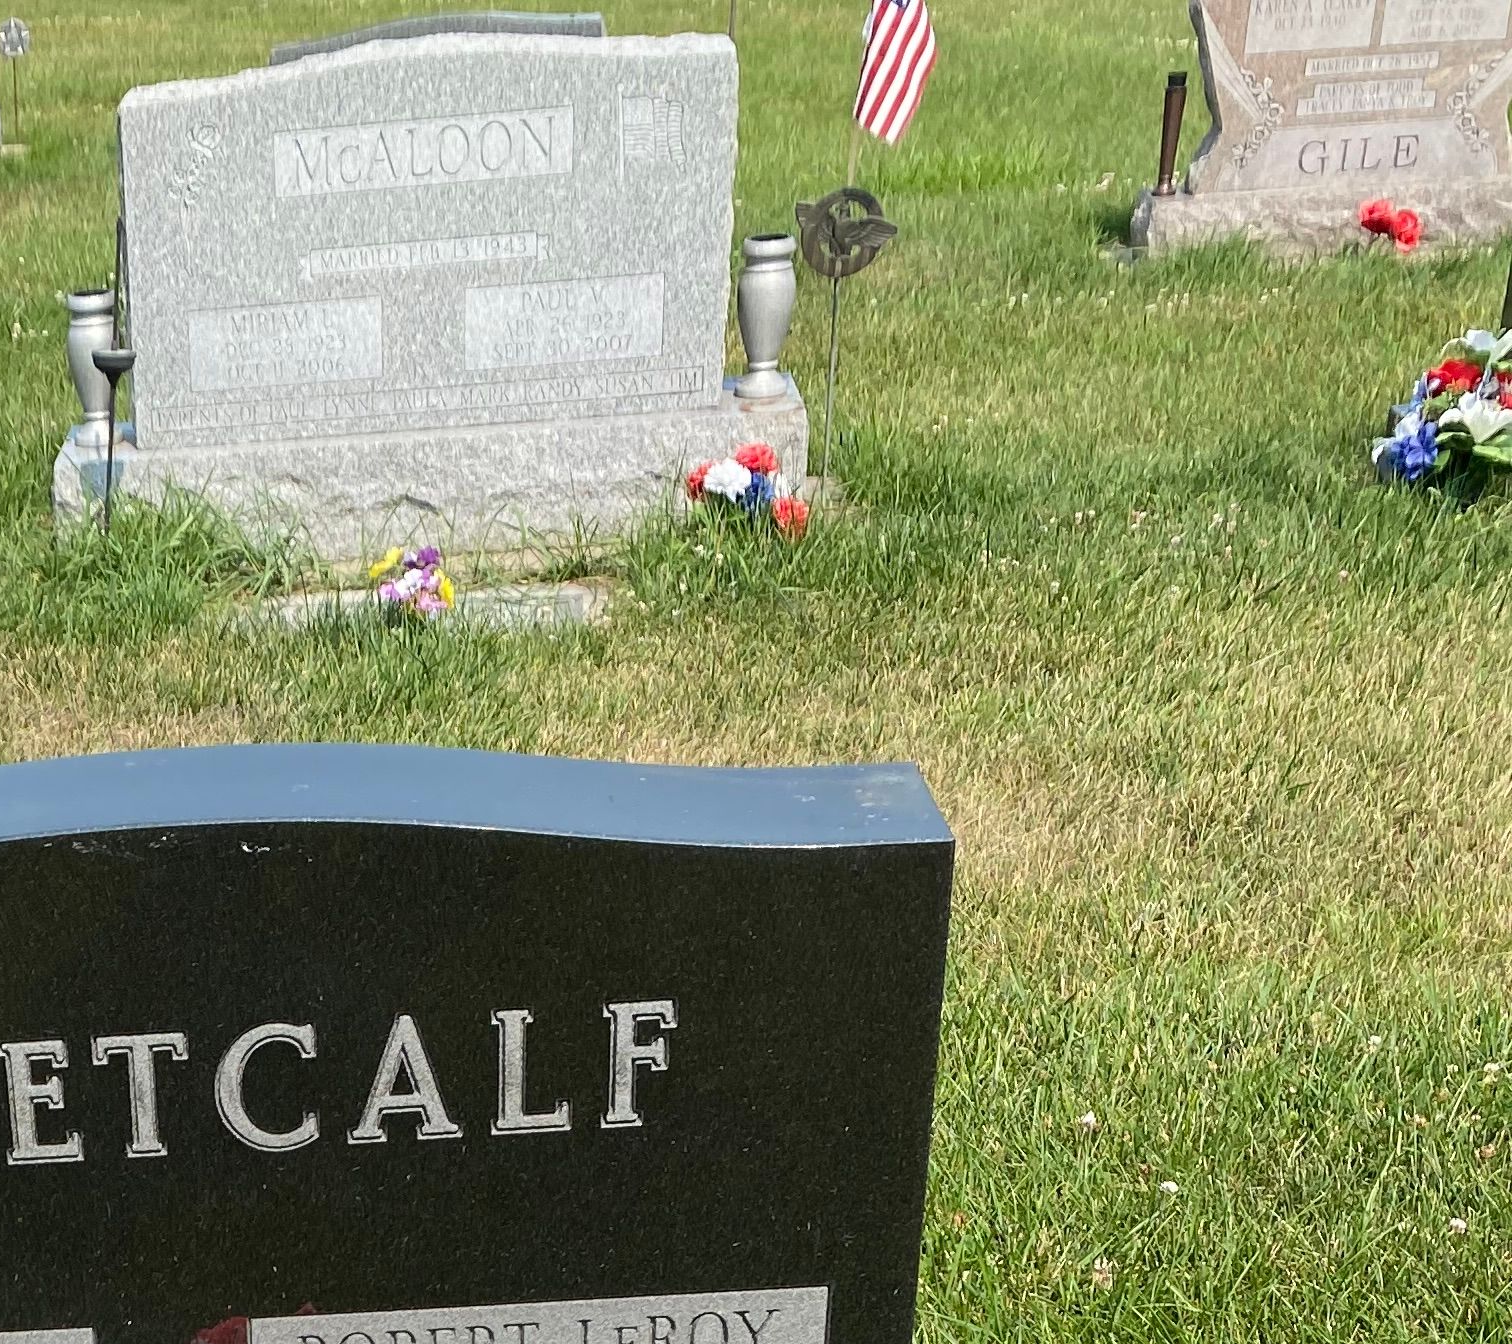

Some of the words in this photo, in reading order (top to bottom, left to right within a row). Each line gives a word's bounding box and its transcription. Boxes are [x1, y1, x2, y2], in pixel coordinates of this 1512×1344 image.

[1311, 55, 1359, 72] MARRIED
[294, 115, 555, 189] McALOON
[1298, 134, 1420, 176] GILE
[320, 245, 398, 271] MARRIED
[483, 235, 528, 257] 1943
[521, 288, 576, 313] PAUL
[231, 309, 309, 335] MIRIAM
[583, 334, 633, 355] 2007
[156, 406, 234, 428] PARENTS
[239, 404, 257, 422] OF
[392, 388, 447, 411] PAULA
[459, 386, 511, 407] MARK
[523, 379, 584, 402] RANDY
[595, 374, 654, 395] SUSAN
[669, 370, 698, 390] TIM
